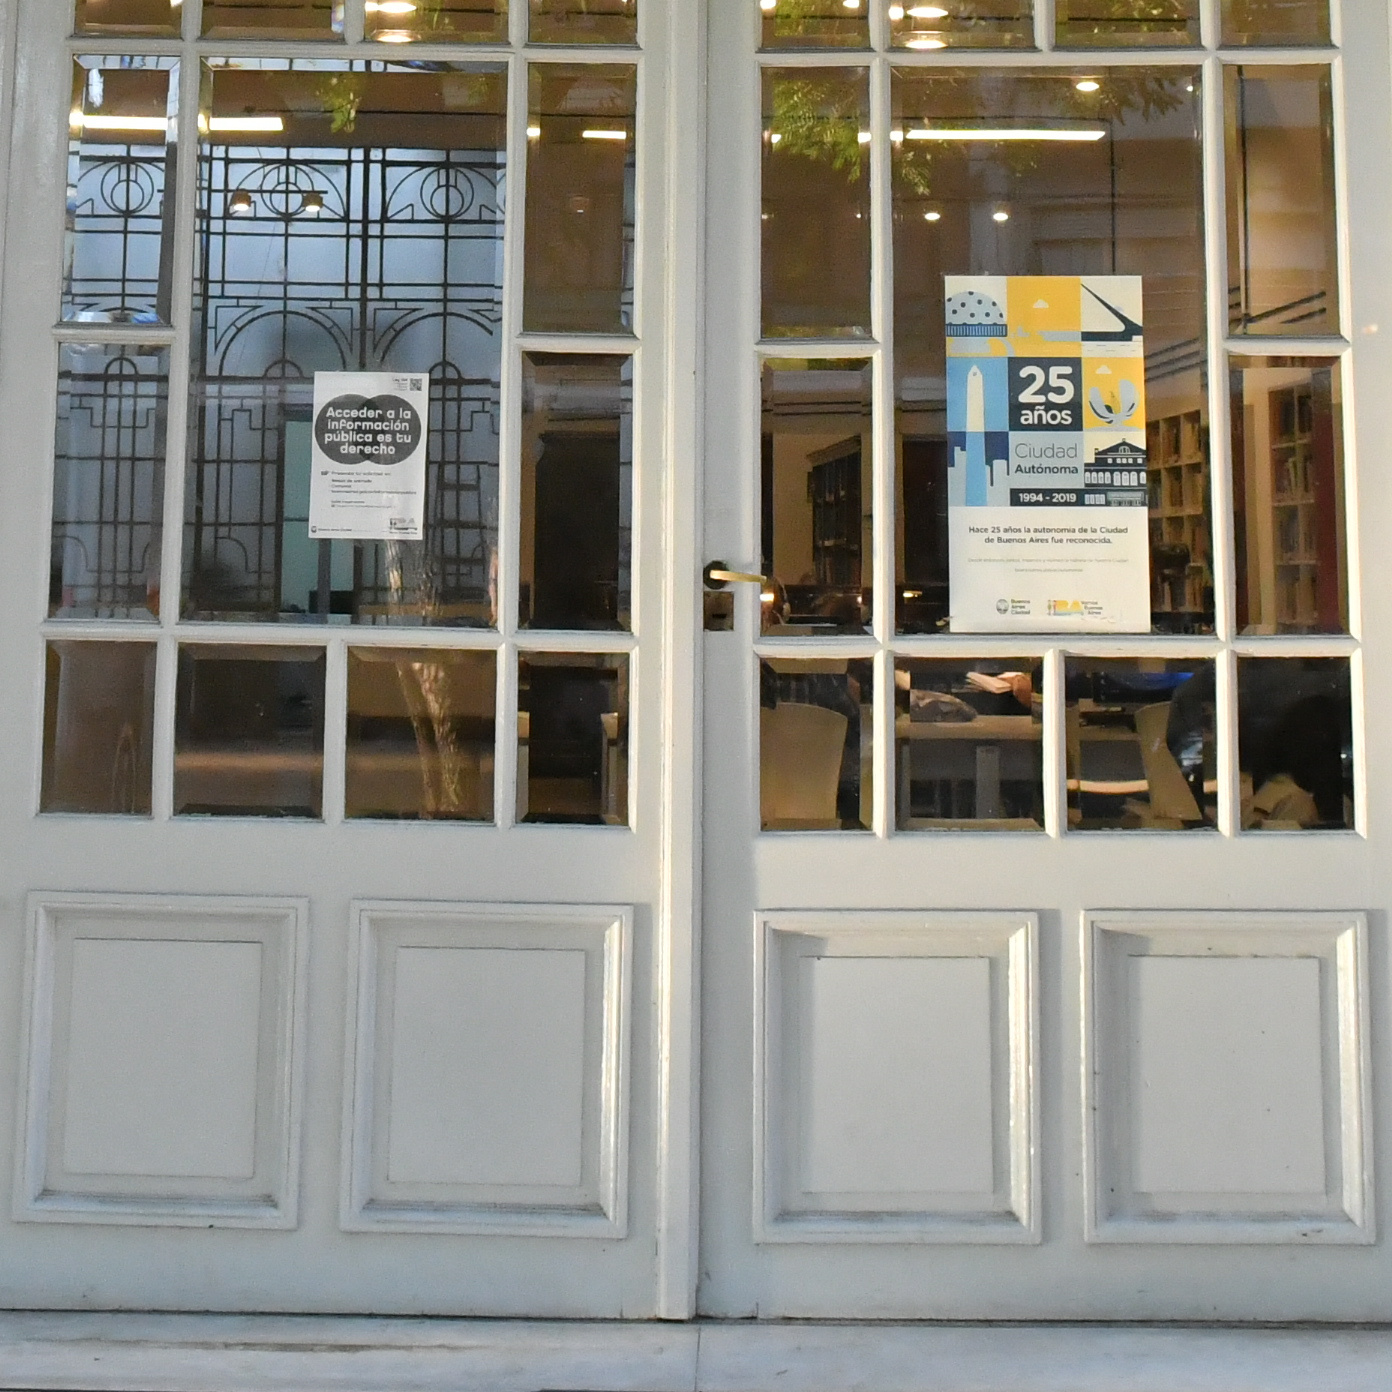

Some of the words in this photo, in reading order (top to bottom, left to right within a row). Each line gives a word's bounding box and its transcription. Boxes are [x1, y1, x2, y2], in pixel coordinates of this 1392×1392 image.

[1018, 365, 1075, 404] 25
[326, 406, 383, 418] Acceder
[387, 410, 395, 419] a
[399, 408, 412, 419] la
[1019, 405, 1073, 427] años
[327, 419, 410, 431] información
[324, 430, 373, 444] pública
[376, 433, 392, 442] es
[396, 433, 412, 443] tu
[339, 442, 396, 455] derecho
[1014, 442, 1078, 459] Ciudad
[1014, 463, 1079, 474] Autónoma
[1018, 493, 1043, 503] 1994
[1051, 493, 1077, 503] 2019
[968, 526, 989, 534] Hace
[991, 526, 1001, 534] 25
[1078, 526, 1088, 534] de
[1099, 526, 1128, 534] Ciudad
[984, 536, 995, 544] de
[997, 536, 1026, 544] Buenos
